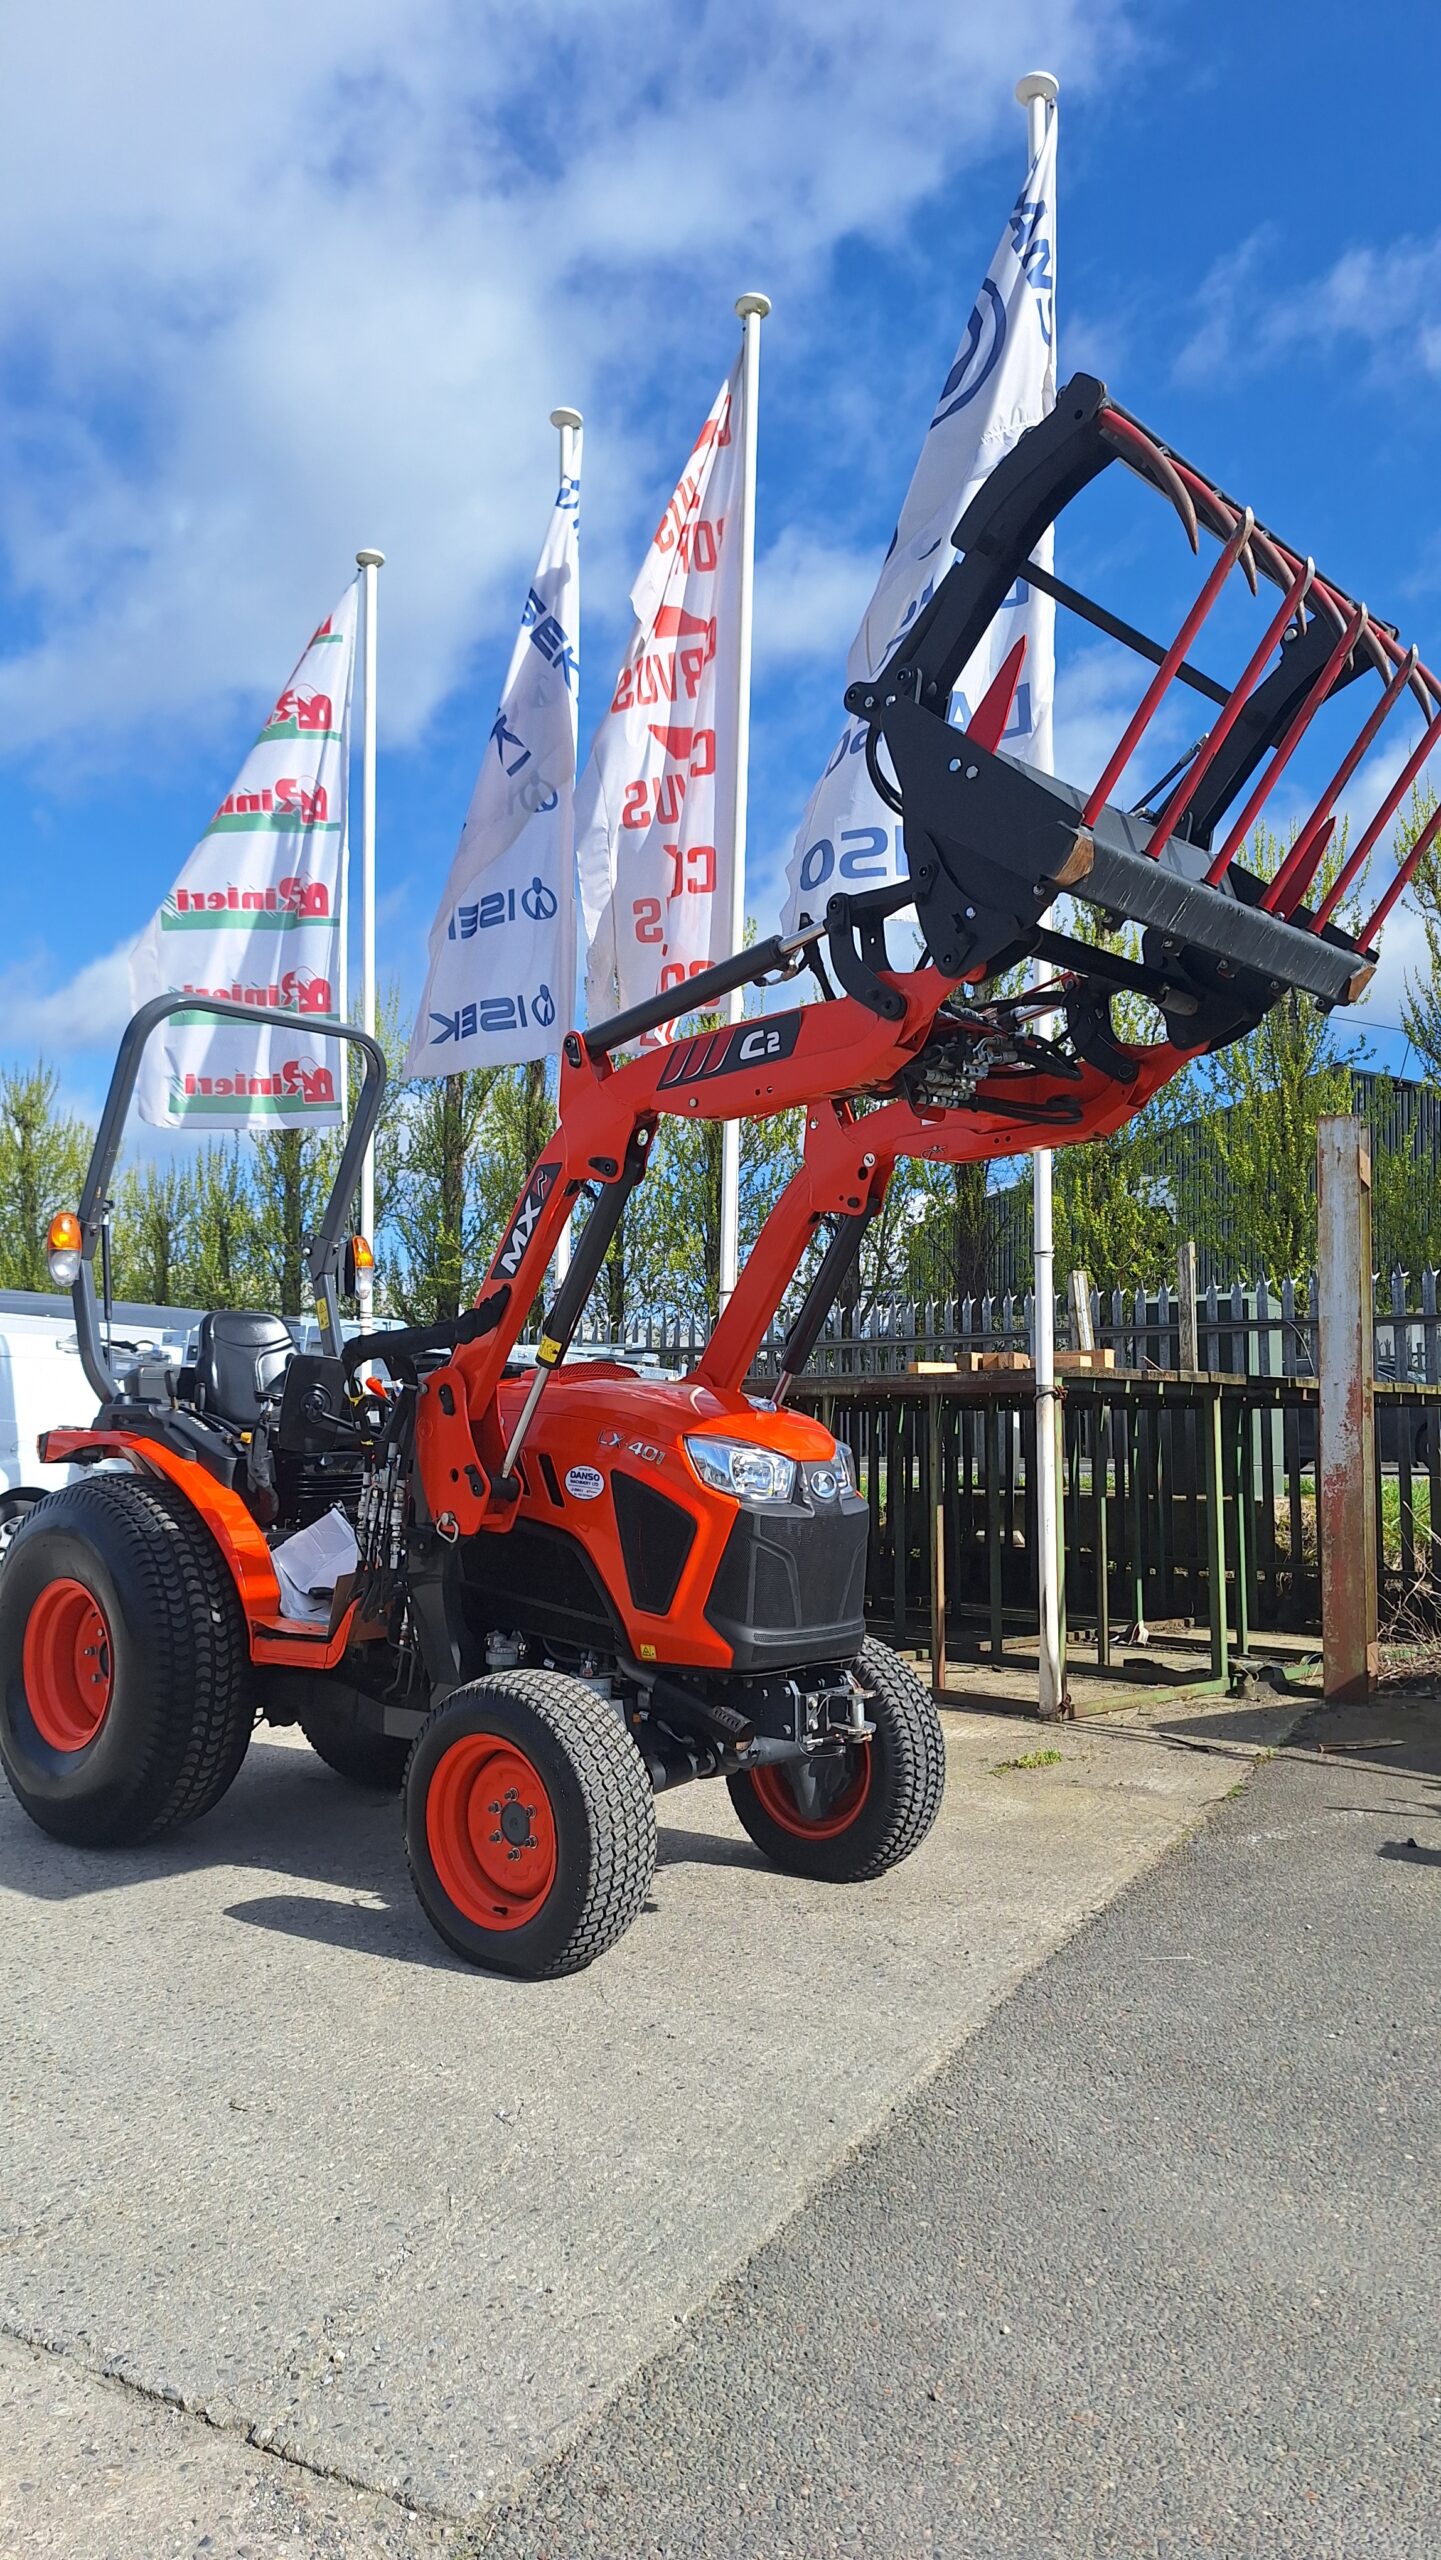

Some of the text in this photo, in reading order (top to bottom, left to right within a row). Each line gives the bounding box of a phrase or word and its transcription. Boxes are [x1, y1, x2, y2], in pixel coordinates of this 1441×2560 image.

[740, 1030, 780, 1060] C2
[500, 1195, 542, 1275] MX
[570, 1471, 601, 1481] DANSO
